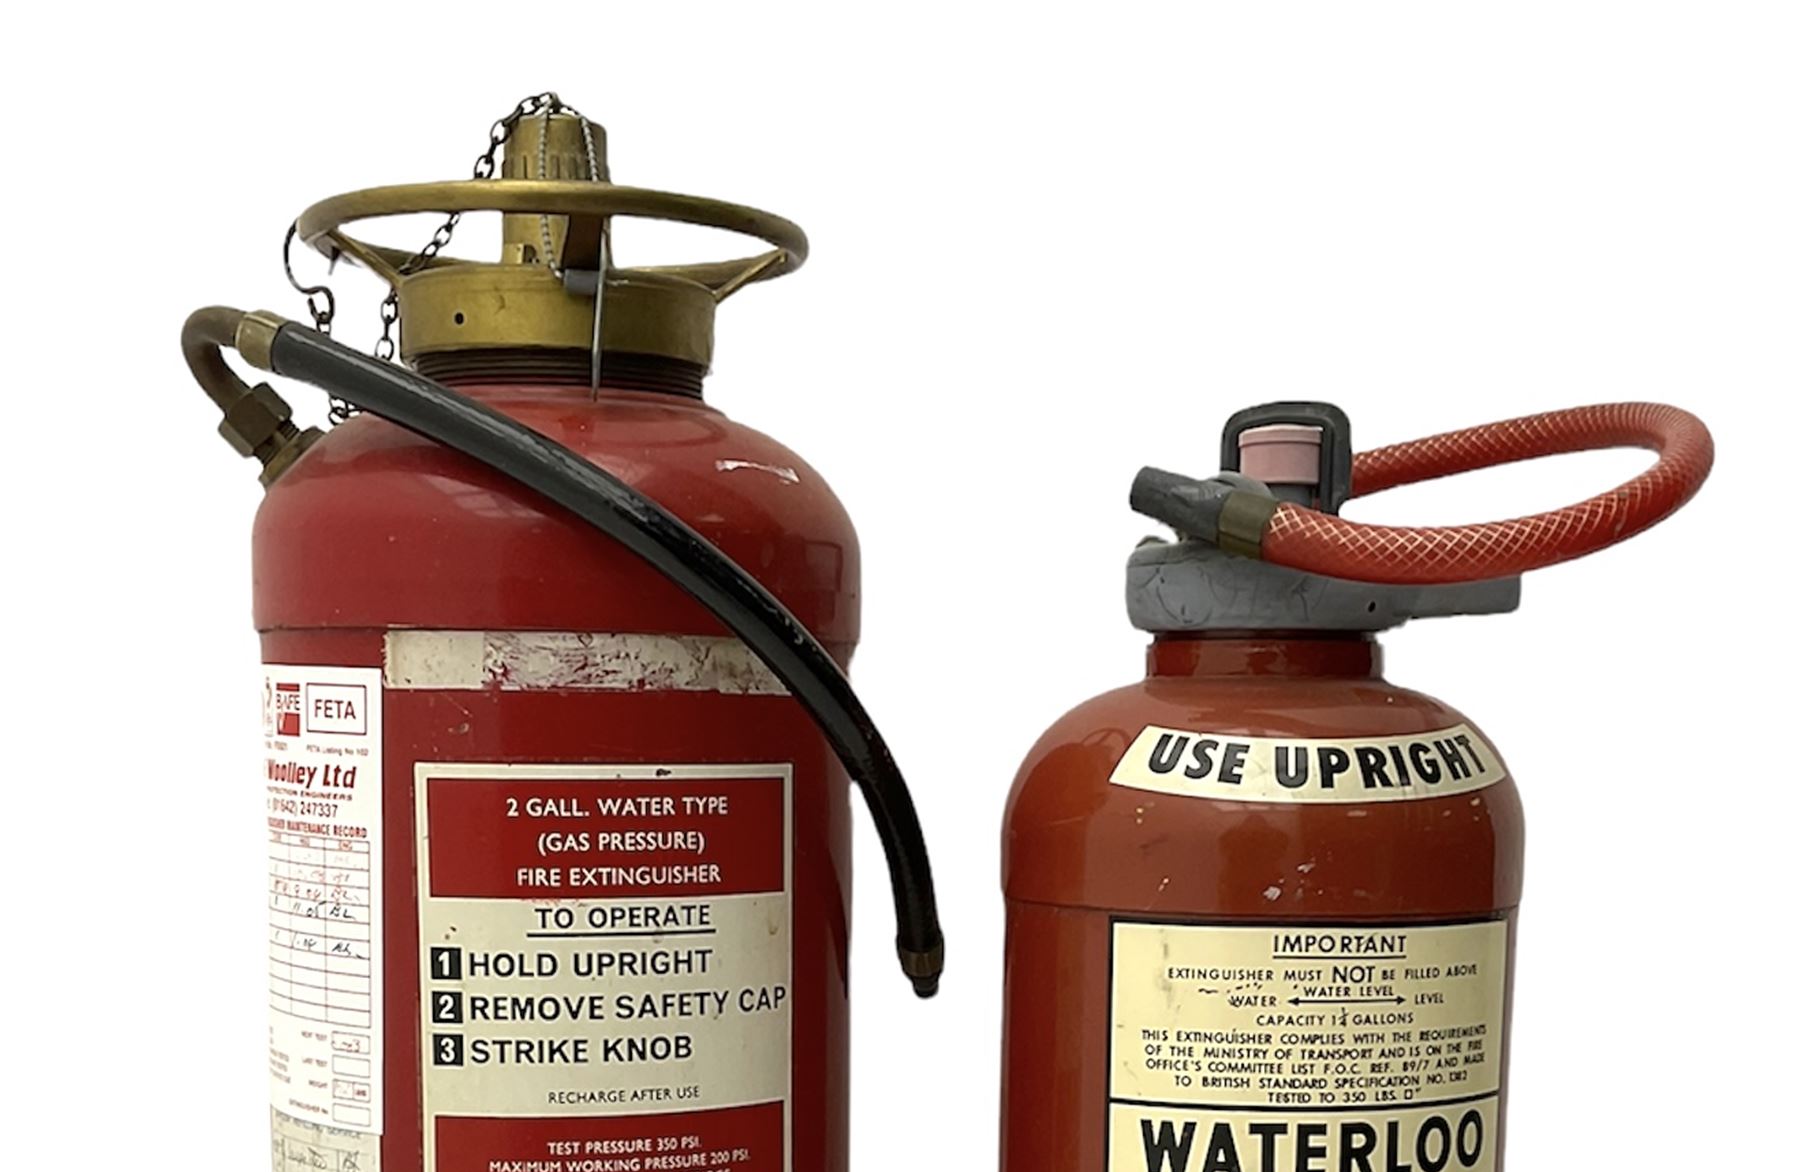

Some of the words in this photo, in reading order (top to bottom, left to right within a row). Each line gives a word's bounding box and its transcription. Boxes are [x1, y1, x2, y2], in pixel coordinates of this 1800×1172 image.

[315, 699, 356, 719] FETA
[1148, 734, 1250, 784] USE
[1275, 735, 1485, 789] UPRIGHT
[323, 764, 357, 788] Ltd
[300, 802, 338, 817] 247337
[506, 799, 519, 817] 2
[526, 799, 589, 816] GALL.
[598, 798, 675, 816] WATER
[682, 797, 728, 815] TYPE
[334, 824, 367, 838] RECORD
[538, 833, 590, 856] (GAS
[598, 832, 705, 854] PRESSURE)
[518, 868, 561, 886] FIRE
[569, 865, 721, 886] EXTINGUISHER
[535, 908, 574, 929] TO
[589, 905, 711, 928] OPERATE
[1274, 934, 1406, 954] IMPORTANT
[438, 952, 451, 976] 1
[469, 953, 558, 977] HOLD
[573, 950, 712, 976] UPRIGHT
[1168, 968, 1274, 981] EXTINGUISHER
[1283, 969, 1322, 981] MUST
[1332, 965, 1375, 983] NOT
[1381, 968, 1395, 980] BE
[1405, 966, 1440, 979] FILLED
[1447, 964, 1477, 976] ABOVE
[1228, 995, 1276, 1007] WATER
[1415, 993, 1444, 1005] LEVEL
[1304, 986, 1351, 997] WATER
[1360, 985, 1394, 996] LEVEL
[439, 996, 454, 1019] 2
[470, 996, 604, 1020] REMOVE
[616, 991, 729, 1019] SAFETY
[739, 987, 786, 1012] CAP
[1256, 1014, 1324, 1026] CAPACITY
[1352, 1012, 1414, 1025] GALLONS
[440, 1038, 456, 1062] 3
[471, 1039, 589, 1063] STRIKE
[603, 1036, 692, 1062] KNOB
[1175, 1076, 1191, 1086] TO
[1202, 1076, 1250, 1088] BRITISH
[1258, 1078, 1327, 1089] STANDARD
[1334, 1075, 1420, 1089] SPECIFICATION
[1427, 1073, 1446, 1085] NO.
[548, 1091, 625, 1104] RECHARGE
[630, 1088, 672, 1101] AFTER
[677, 1086, 700, 1099] USE
[548, 1142, 580, 1155] TEST
[585, 1140, 652, 1153] PRESSURE
[657, 1138, 677, 1151] 350
[567, 1159, 641, 1172] WORKING
[645, 1153, 707, 1169] PRESSURE
[710, 1152, 729, 1164] 200
